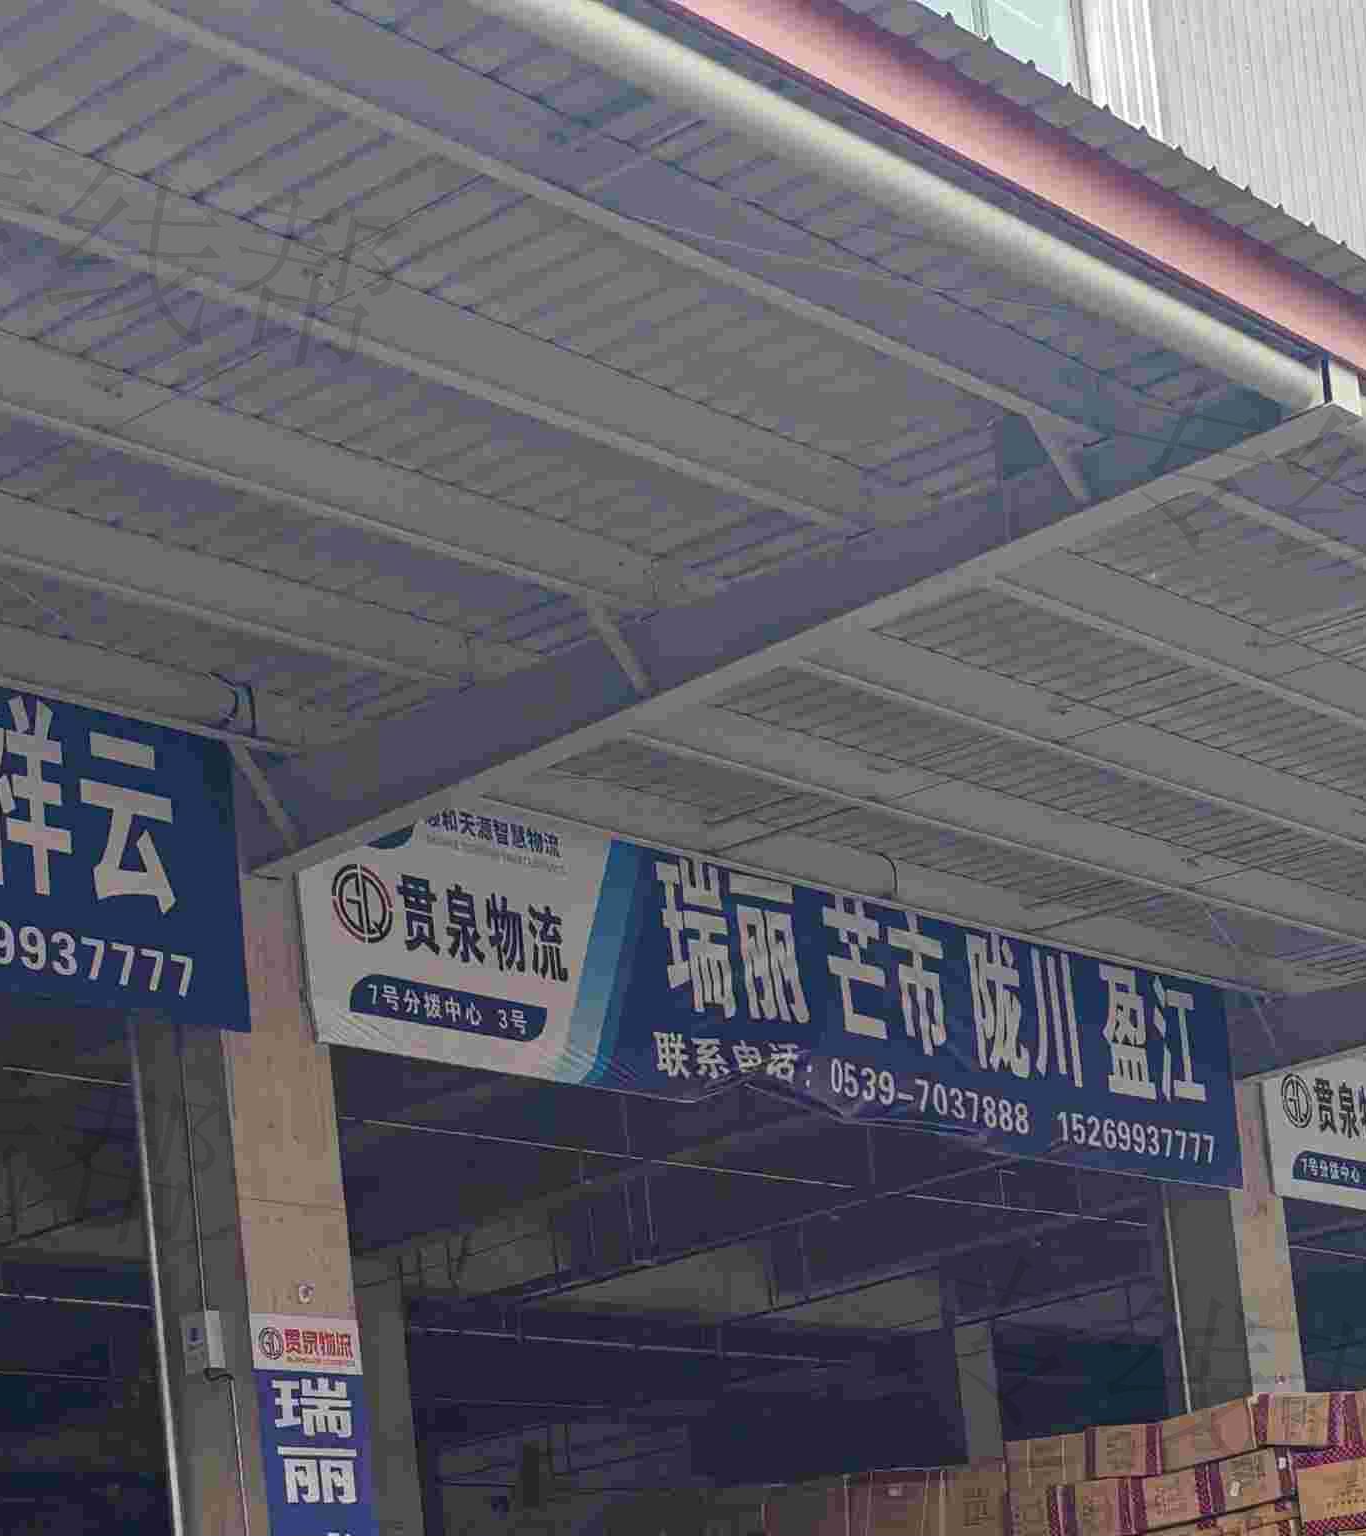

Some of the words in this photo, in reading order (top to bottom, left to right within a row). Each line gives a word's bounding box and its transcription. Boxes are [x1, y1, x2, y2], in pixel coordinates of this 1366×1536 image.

[396, 873, 569, 982] 贯泉物流
[654, 856, 810, 1025] 瑞丽
[822, 897, 948, 1056] 芒市
[965, 932, 1083, 1087] 陇川
[1099, 962, 1207, 1102] 盈江
[829, 1057, 1031, 1135] 0539-7037888
[1056, 1110, 1216, 1164] 15269937777
[271, 1376, 359, 1504] 瑞丽
